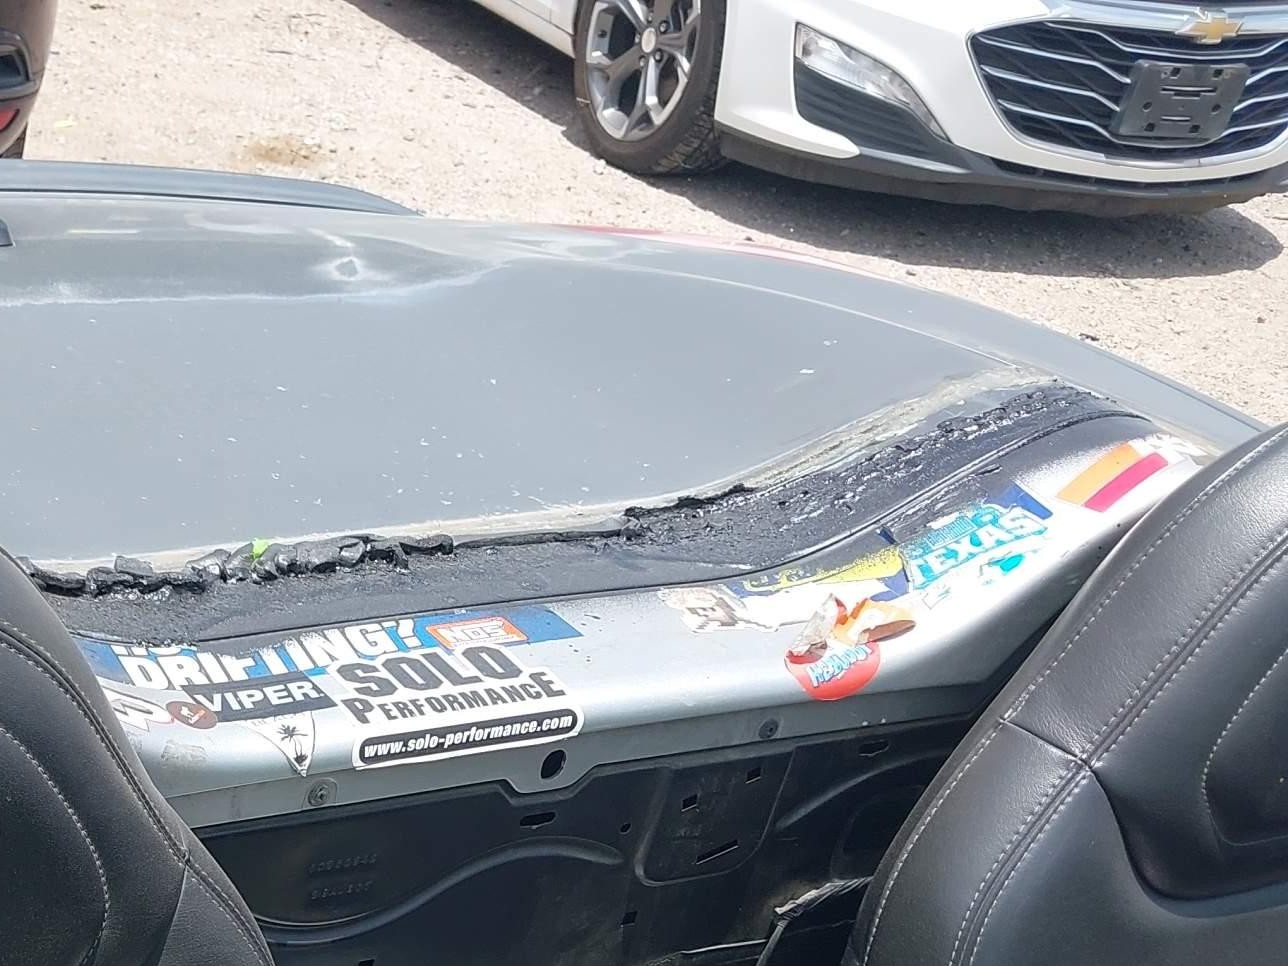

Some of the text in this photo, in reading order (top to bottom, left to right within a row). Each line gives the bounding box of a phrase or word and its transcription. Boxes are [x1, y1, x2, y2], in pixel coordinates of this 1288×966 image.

[910, 508, 1048, 590] TEXAS
[438, 621, 508, 644] NOS
[336, 646, 523, 697] SOLO
[194, 679, 321, 712] VIPER
[341, 671, 566, 724] PERFORMANCE
[364, 715, 573, 758] www.solo-performance.com
